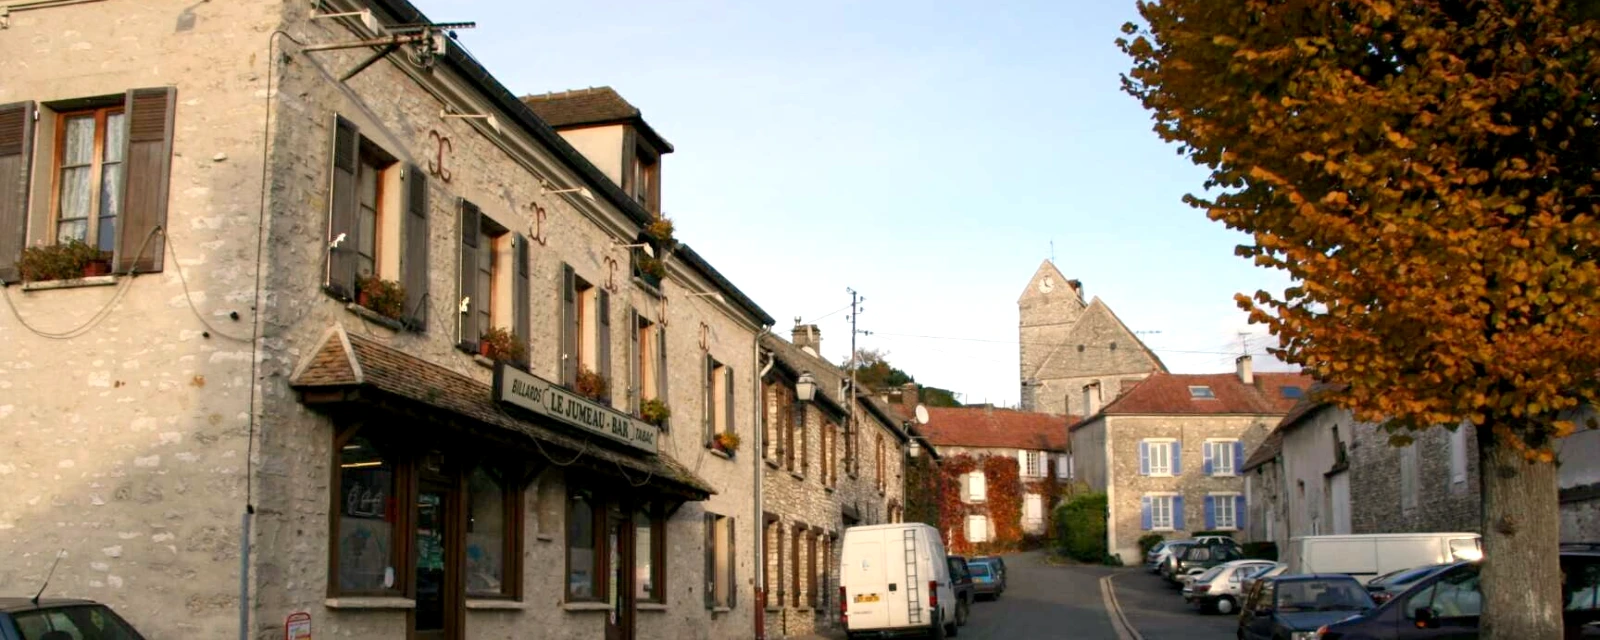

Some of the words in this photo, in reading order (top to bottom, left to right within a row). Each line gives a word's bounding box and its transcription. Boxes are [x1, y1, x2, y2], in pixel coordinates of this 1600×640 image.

[512, 378, 542, 403] BILLARDS
[551, 392, 564, 415] LE
[566, 398, 605, 429] JUMEAU
[612, 416, 629, 439] BAR
[635, 427, 654, 446] TABAC
